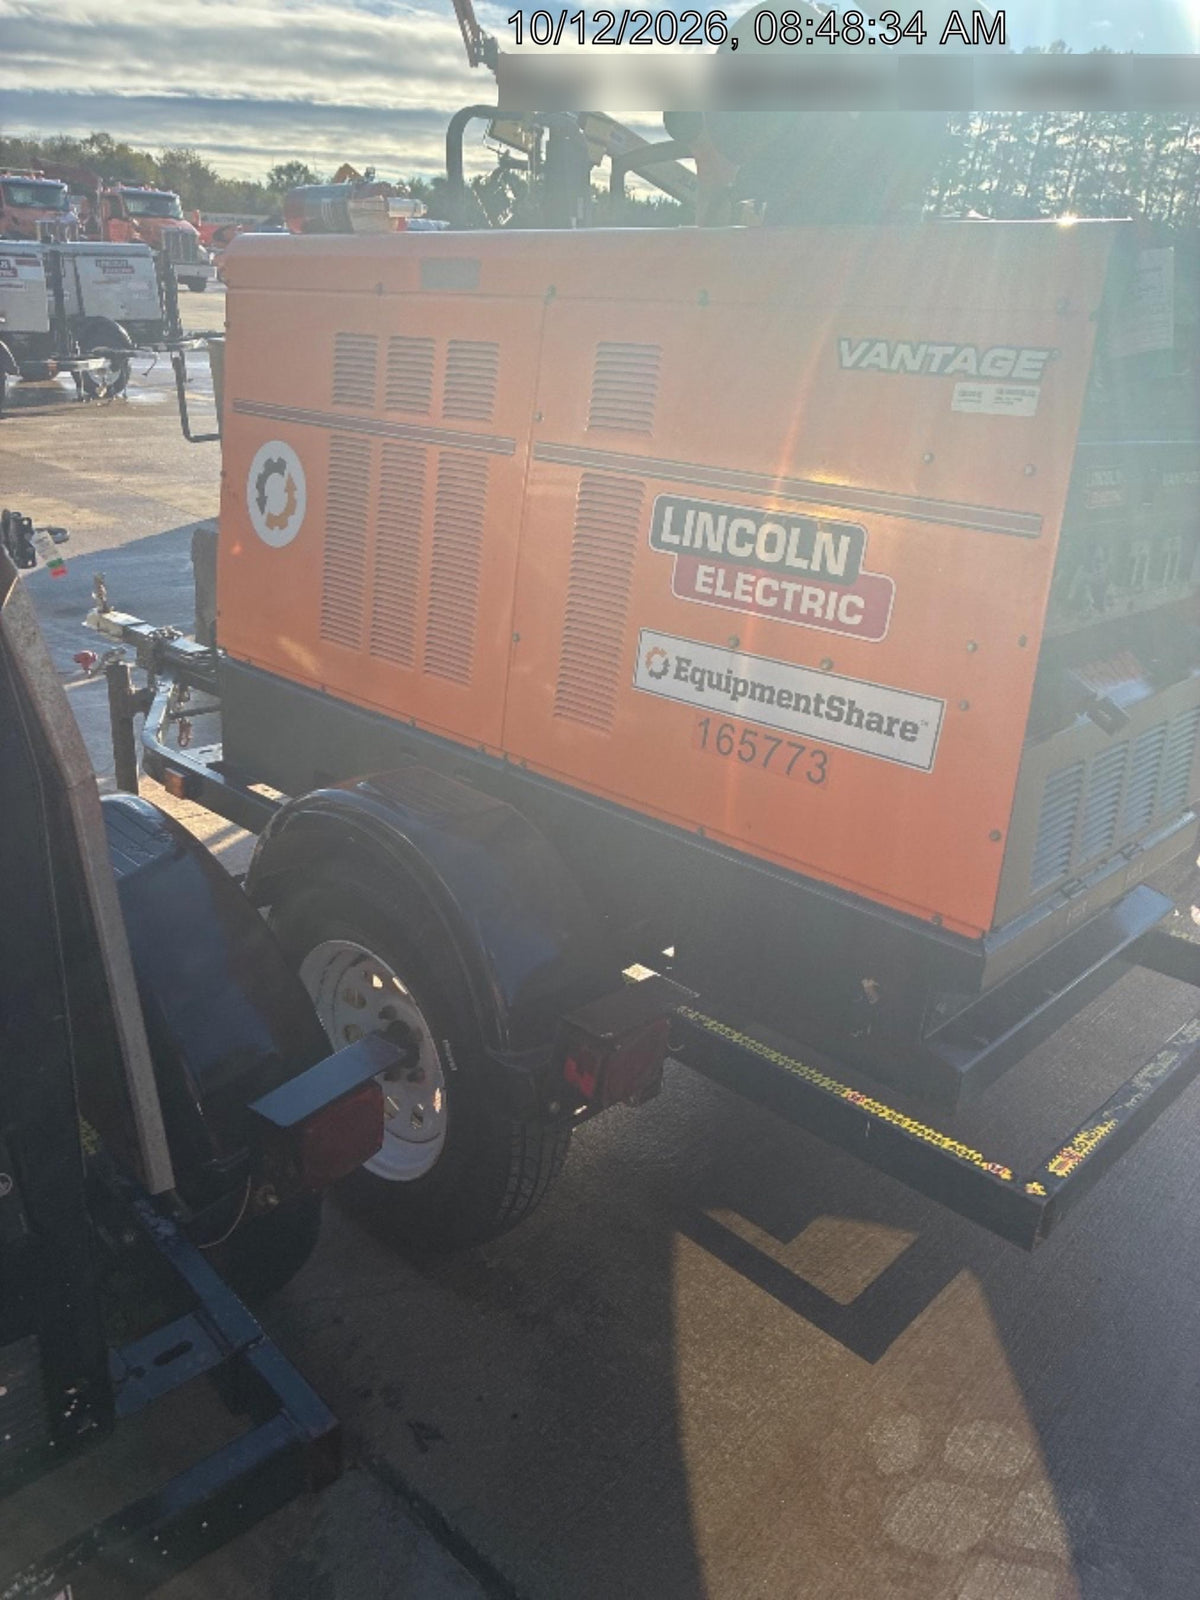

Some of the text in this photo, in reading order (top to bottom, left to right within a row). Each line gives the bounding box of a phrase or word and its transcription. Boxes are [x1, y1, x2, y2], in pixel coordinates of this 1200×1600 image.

[839, 338, 1049, 380] VANTAGE
[660, 505, 851, 577] LINCOLN
[694, 564, 866, 626] ELECTRIC
[697, 717, 828, 786] 165773
